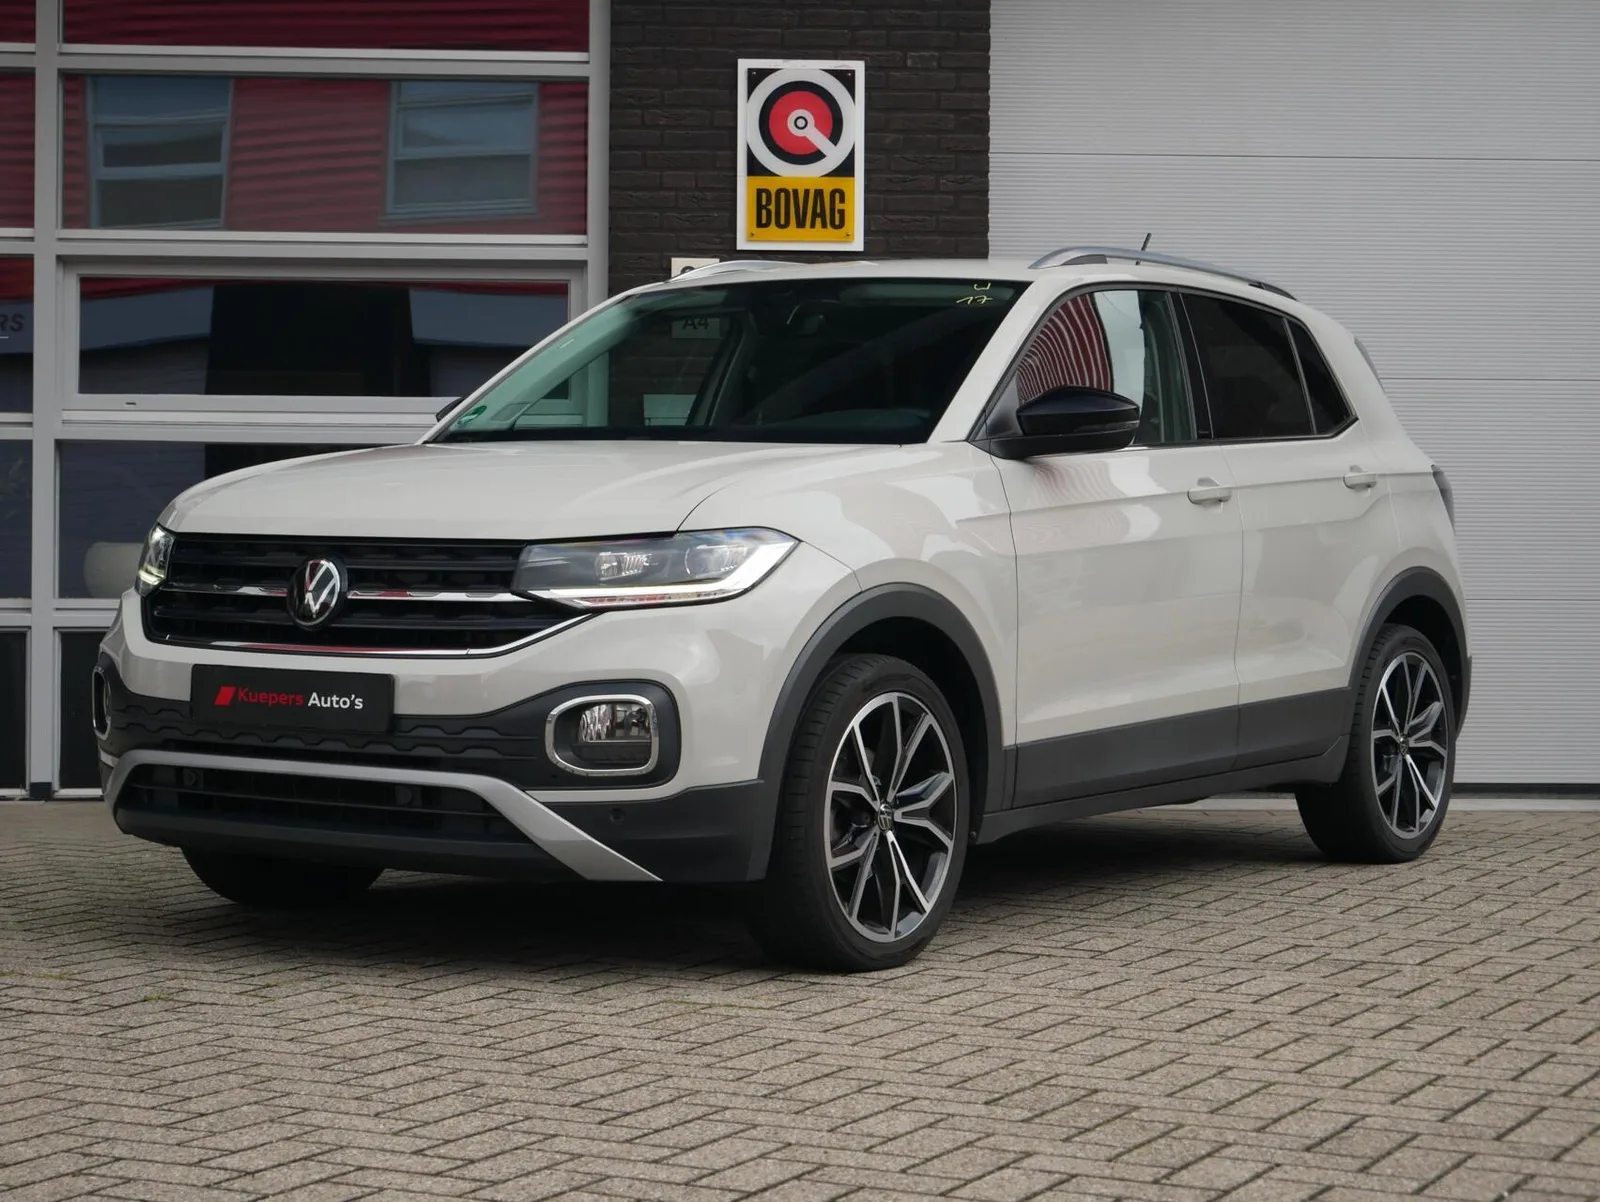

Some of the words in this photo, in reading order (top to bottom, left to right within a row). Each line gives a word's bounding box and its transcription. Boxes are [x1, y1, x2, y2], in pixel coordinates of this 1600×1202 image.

[756, 188, 846, 229] BOVAG
[238, 687, 303, 706] Kuepers
[308, 692, 364, 709] Auto's
